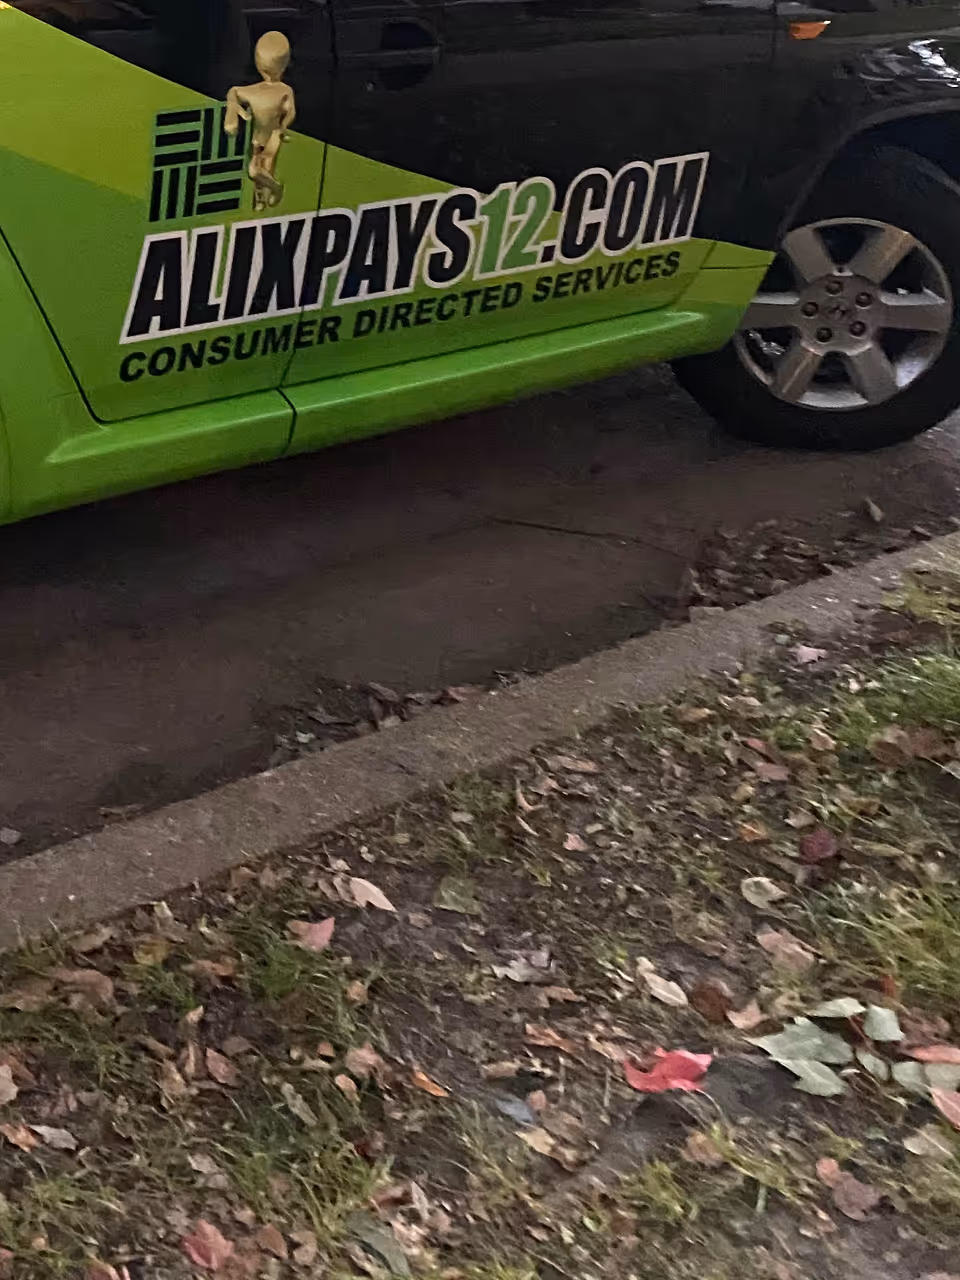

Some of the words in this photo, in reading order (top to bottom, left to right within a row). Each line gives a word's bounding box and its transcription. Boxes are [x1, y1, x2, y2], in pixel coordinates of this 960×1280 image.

[119, 151, 710, 345] ALIXPAYS12.COM
[119, 315, 342, 383] CONSUMER
[352, 281, 522, 338] DIRECTED
[532, 250, 680, 303] SERVICES
